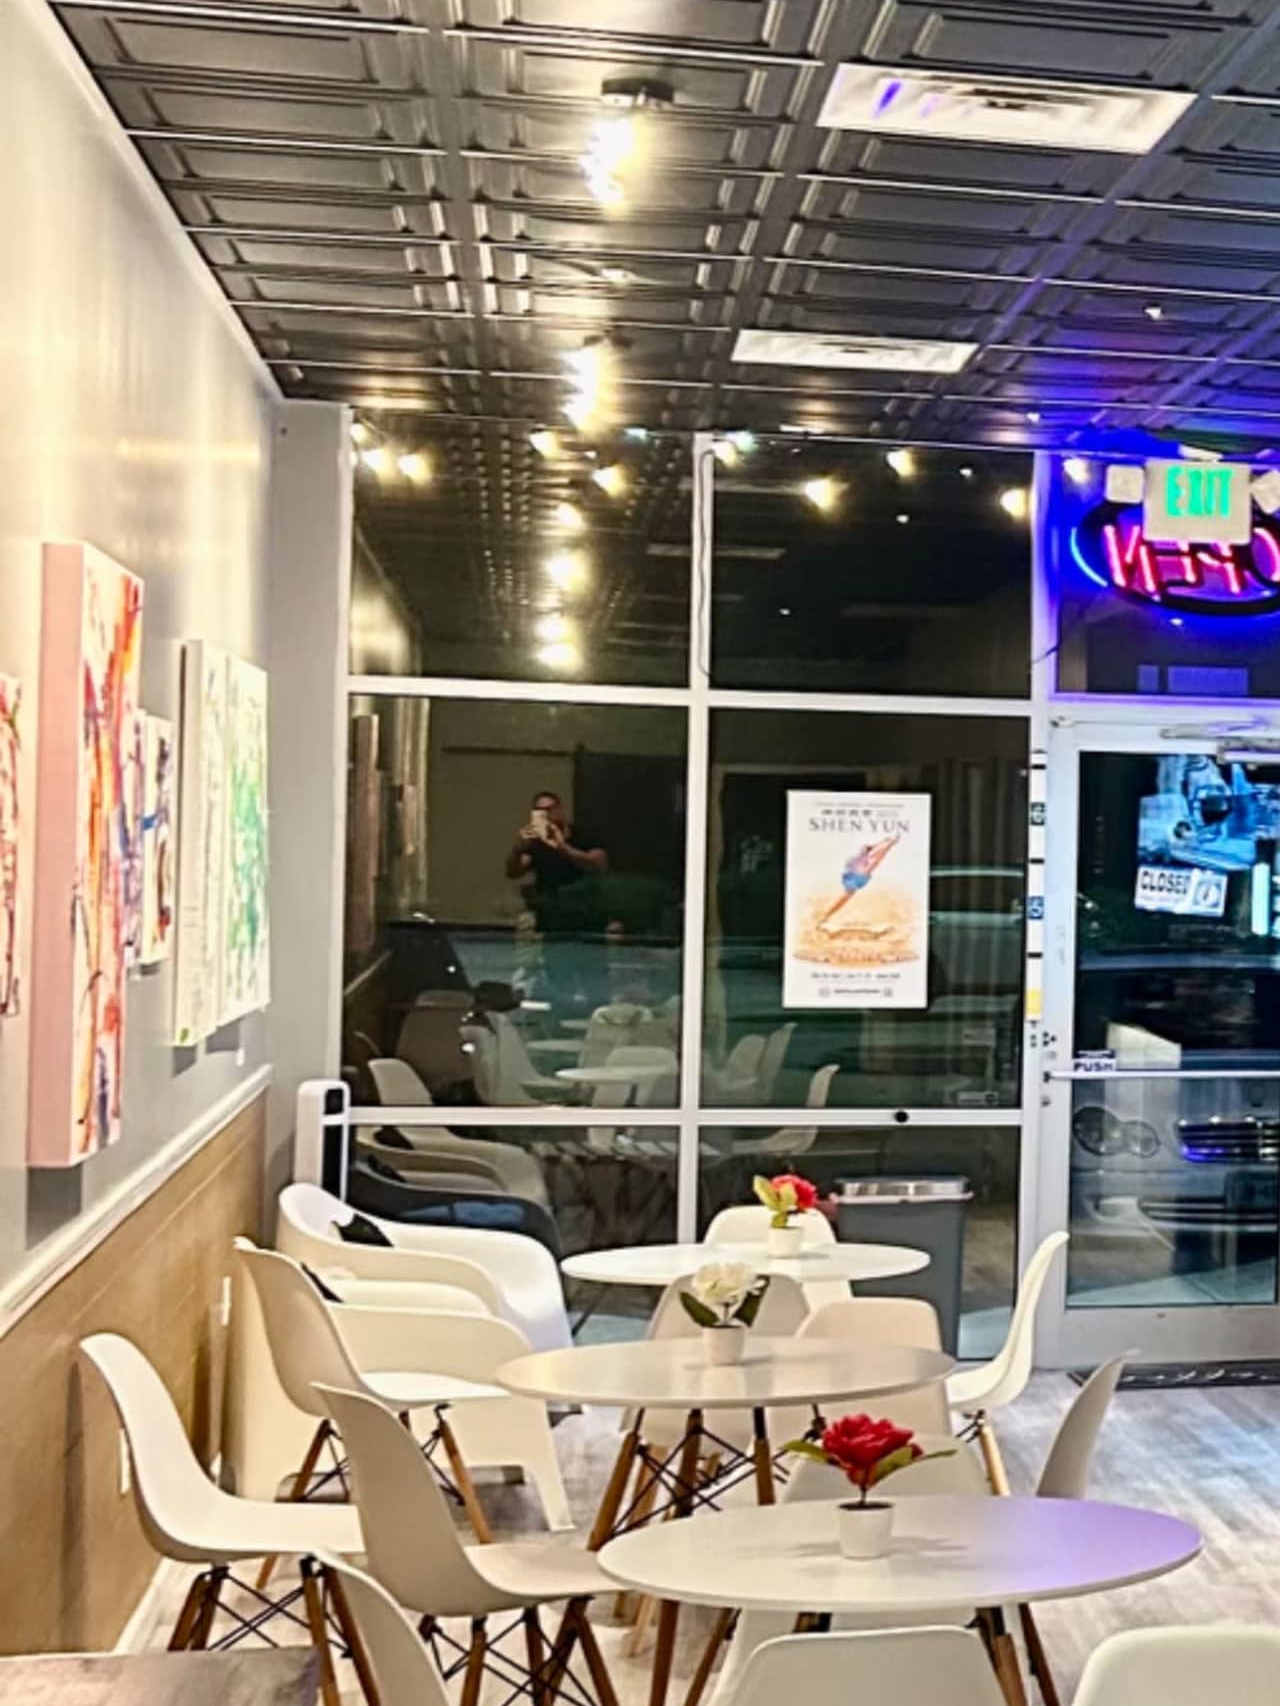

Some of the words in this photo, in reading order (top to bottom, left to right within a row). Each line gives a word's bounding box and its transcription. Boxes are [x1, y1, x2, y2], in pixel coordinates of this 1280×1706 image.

[1166, 465, 1233, 518] EXIT
[809, 818, 863, 832] SHEN
[868, 820, 911, 833] YUN
